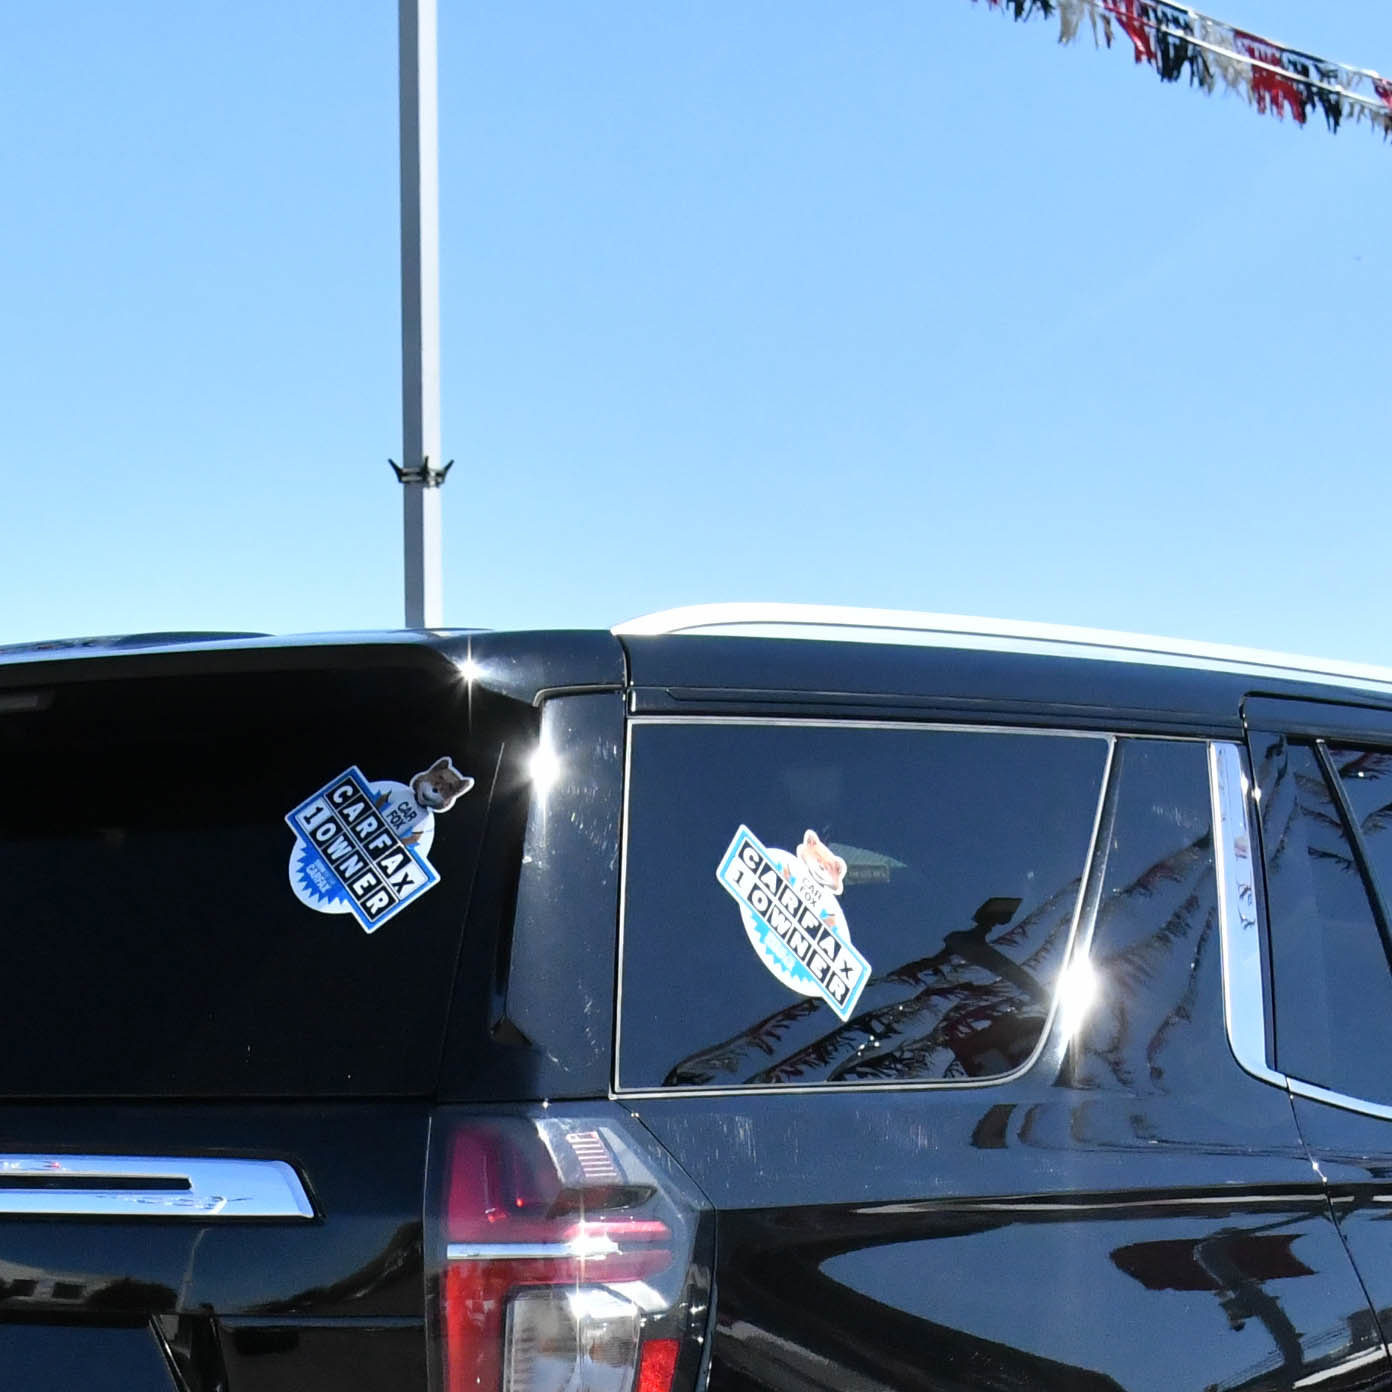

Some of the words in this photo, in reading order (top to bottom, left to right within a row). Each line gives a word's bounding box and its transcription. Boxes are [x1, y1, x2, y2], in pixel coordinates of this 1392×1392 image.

[332, 784, 415, 895] CARFAX
[385, 811, 406, 830] FOX
[397, 801, 417, 823] CAR
[742, 847, 854, 980] CARFAX
